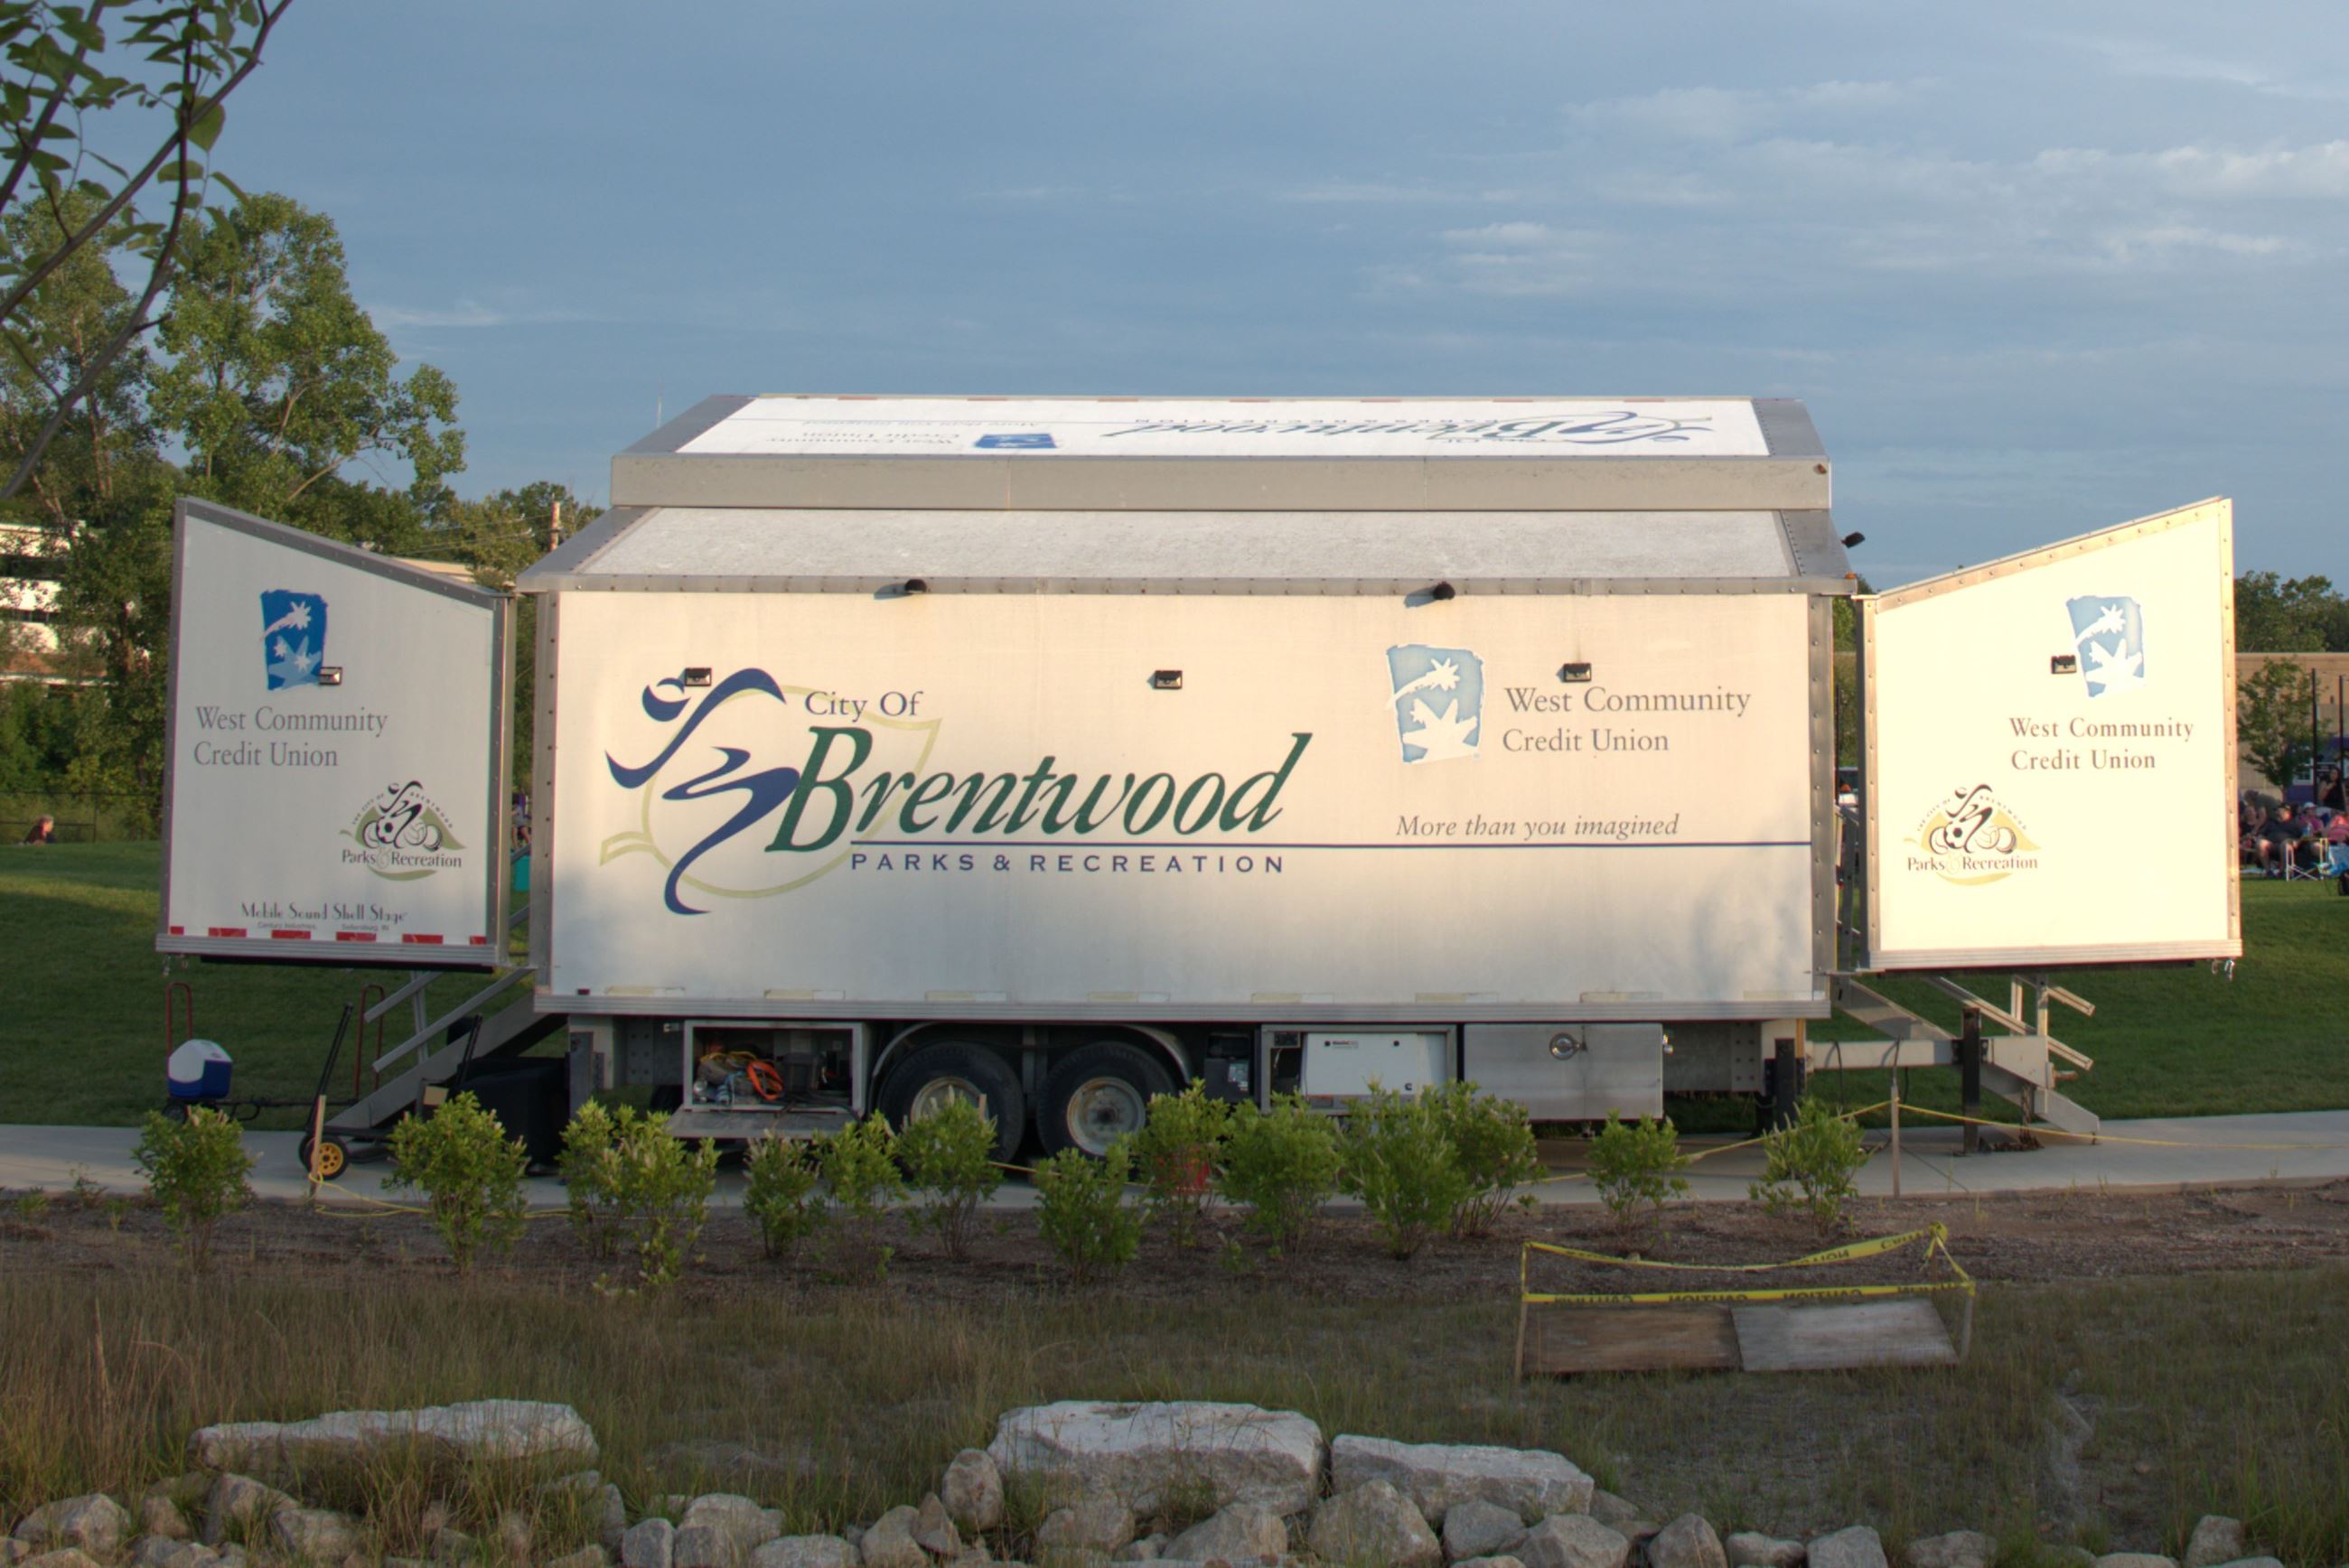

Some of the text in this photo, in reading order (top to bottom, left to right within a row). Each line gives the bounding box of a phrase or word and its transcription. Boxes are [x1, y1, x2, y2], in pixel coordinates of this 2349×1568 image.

[804, 689, 924, 723] City Of
[1504, 686, 1752, 717] West Community
[195, 705, 388, 738] West Community
[2008, 716, 2195, 742] West Community
[1502, 727, 1670, 752] Credit Union
[193, 741, 339, 767] Credit Union
[2010, 748, 2156, 770] Credit Union
[764, 725, 1313, 854] Brentwood
[1396, 813, 1680, 841] More than you imagined
[342, 849, 377, 864] Parks
[391, 851, 462, 868] Recreation
[851, 853, 1283, 873] PARKS & RECREATION
[1907, 856, 1945, 872] Parks
[1962, 855, 2038, 871] Recreation
[241, 901, 284, 919] Mobile
[289, 902, 327, 919] Sound
[332, 903, 364, 920] Shell
